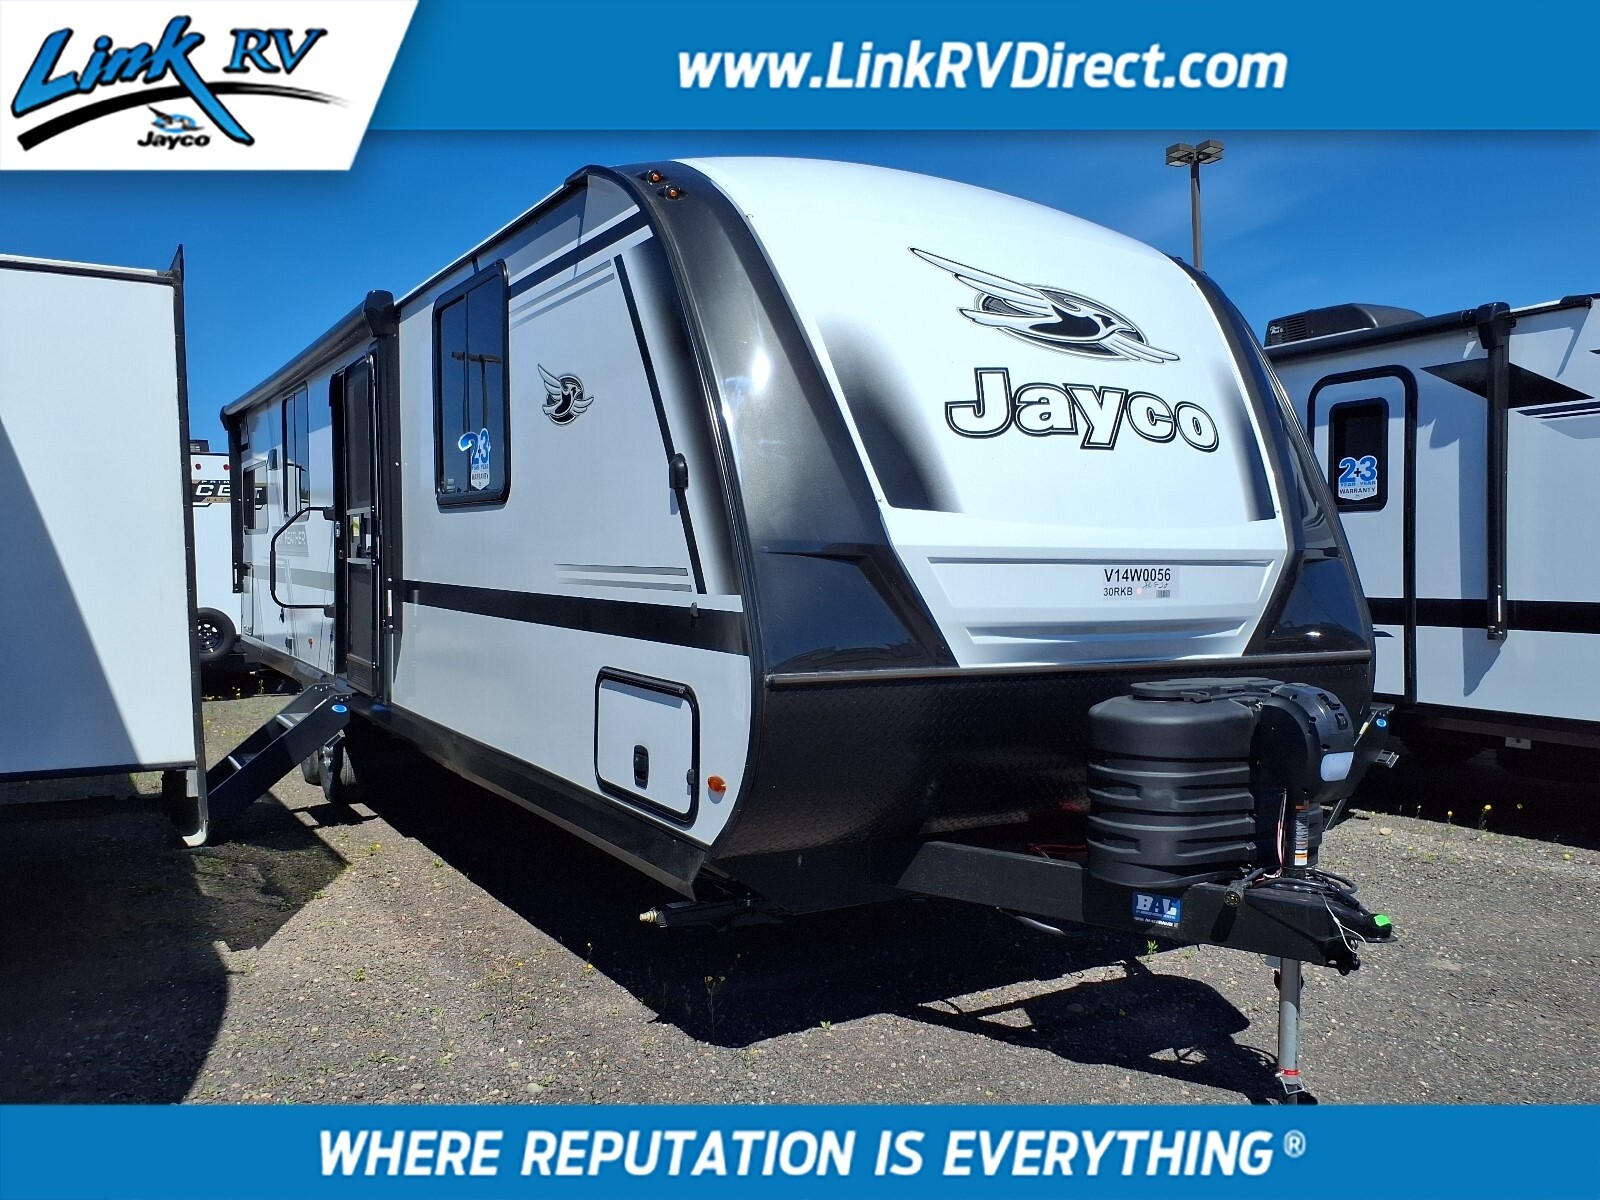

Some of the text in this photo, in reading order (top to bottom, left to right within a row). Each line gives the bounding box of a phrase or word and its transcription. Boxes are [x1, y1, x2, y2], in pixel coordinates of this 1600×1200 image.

[945, 367, 1220, 453] Jayco
[1340, 487, 1376, 495] WARRANTY
[1104, 568, 1171, 582] V14W0056
[1103, 587, 1133, 596] 30RKB
